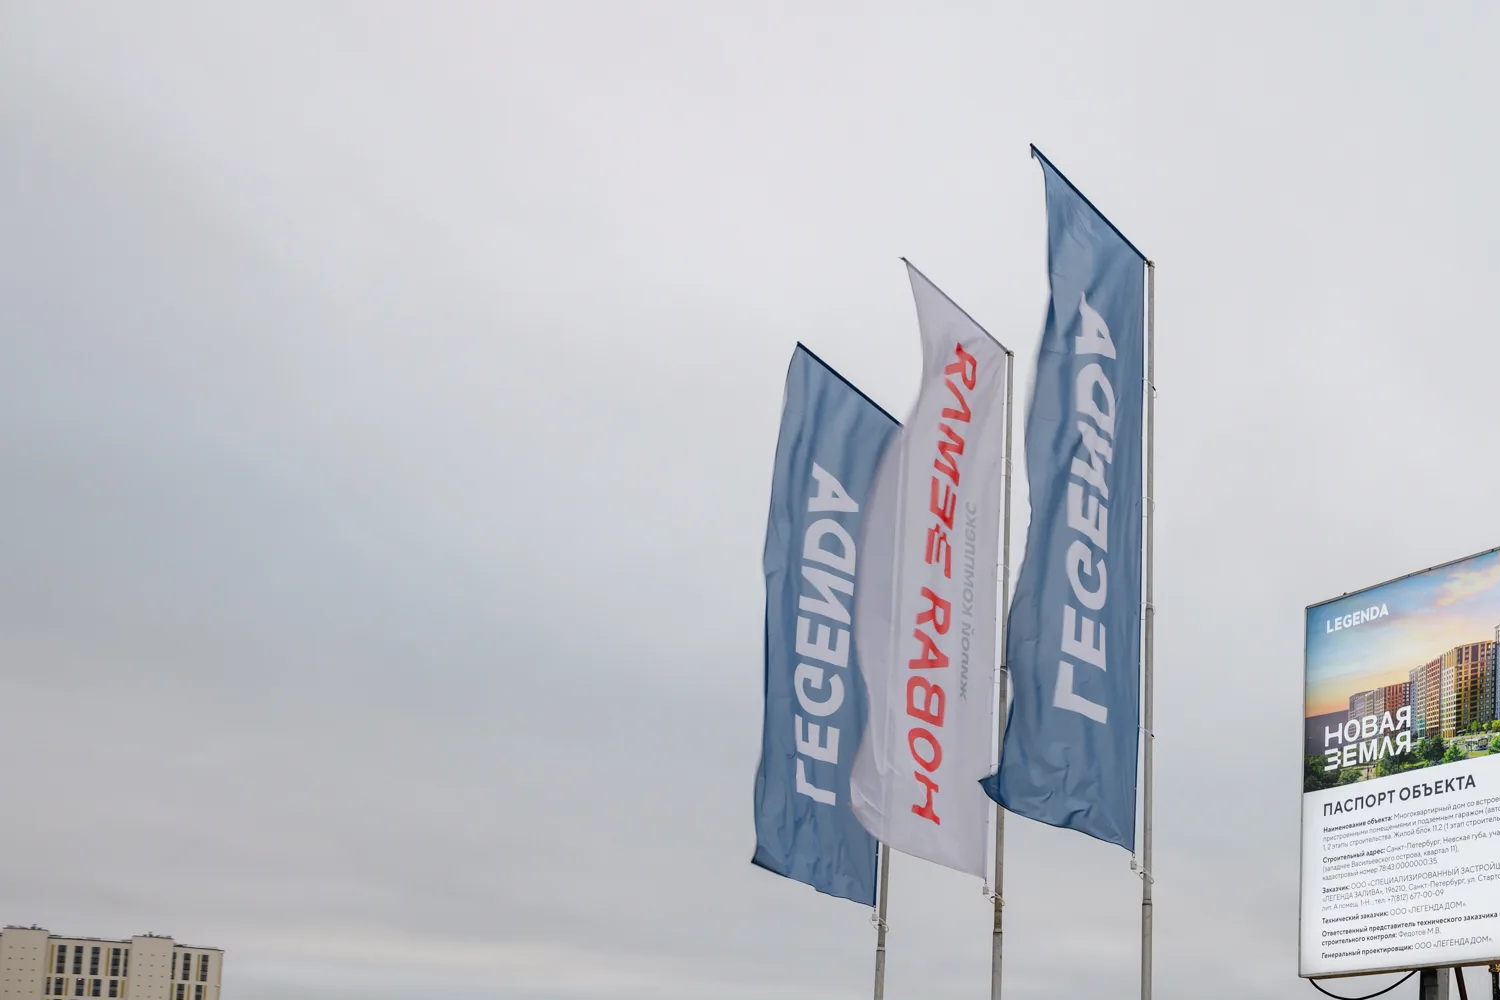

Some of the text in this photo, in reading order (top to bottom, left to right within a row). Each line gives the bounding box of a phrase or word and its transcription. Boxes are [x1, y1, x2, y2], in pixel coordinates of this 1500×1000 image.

[1325, 601, 1389, 633] LEGENDA
[1324, 704, 1411, 748] НОВАЯ
[1323, 729, 1411, 772] ЗЕМЛЯ
[1323, 773, 1476, 816] ПАСПОРТ ОБЪЕКТА
[1323, 820, 1366, 833] Наименование
[1366, 814, 1392, 825] объекта:
[1393, 803, 1451, 820] Многоквартирный
[1451, 802, 1465, 810] дом
[1417, 813, 1453, 825] подземным
[1454, 808, 1483, 820] гаражом
[1322, 850, 1365, 864] Строительный
[1365, 848, 1385, 857] адрес:
[1442, 833, 1470, 844] Невская
[1471, 830, 1487, 841] губа,
[1331, 841, 1348, 849] этапы
[1393, 828, 1414, 838] Жилой
[1415, 825, 1431, 835] блок
[1443, 822, 1448, 831] (1
[1449, 821, 1464, 829] этап
[1423, 846, 1449, 857] квартал
[1359, 867, 1378, 876] номер
[1321, 884, 1350, 894] Заказчик:
[1350, 880, 1366, 890] ООО
[1409, 887, 1444, 900] 677-00-09
[1321, 913, 1359, 924] Технический
[1360, 910, 1388, 919] заказчик:
[1389, 906, 1406, 916] ООО
[1407, 902, 1443, 914] «ЛЕГЕНДА
[1321, 925, 1367, 937] Ответственный
[1368, 921, 1416, 933] представитель
[1416, 915, 1462, 926] технического
[1463, 911, 1498, 921] заказчика
[1321, 935, 1365, 947] строительного
[1366, 932, 1397, 942] контроля:
[1397, 928, 1426, 938] Федотов
[1321, 948, 1360, 960] Генеральный
[1361, 944, 1413, 956] проектировщик:
[1414, 940, 1432, 950] ООО
[1432, 936, 1469, 948] «ЛЕГЕНДА
